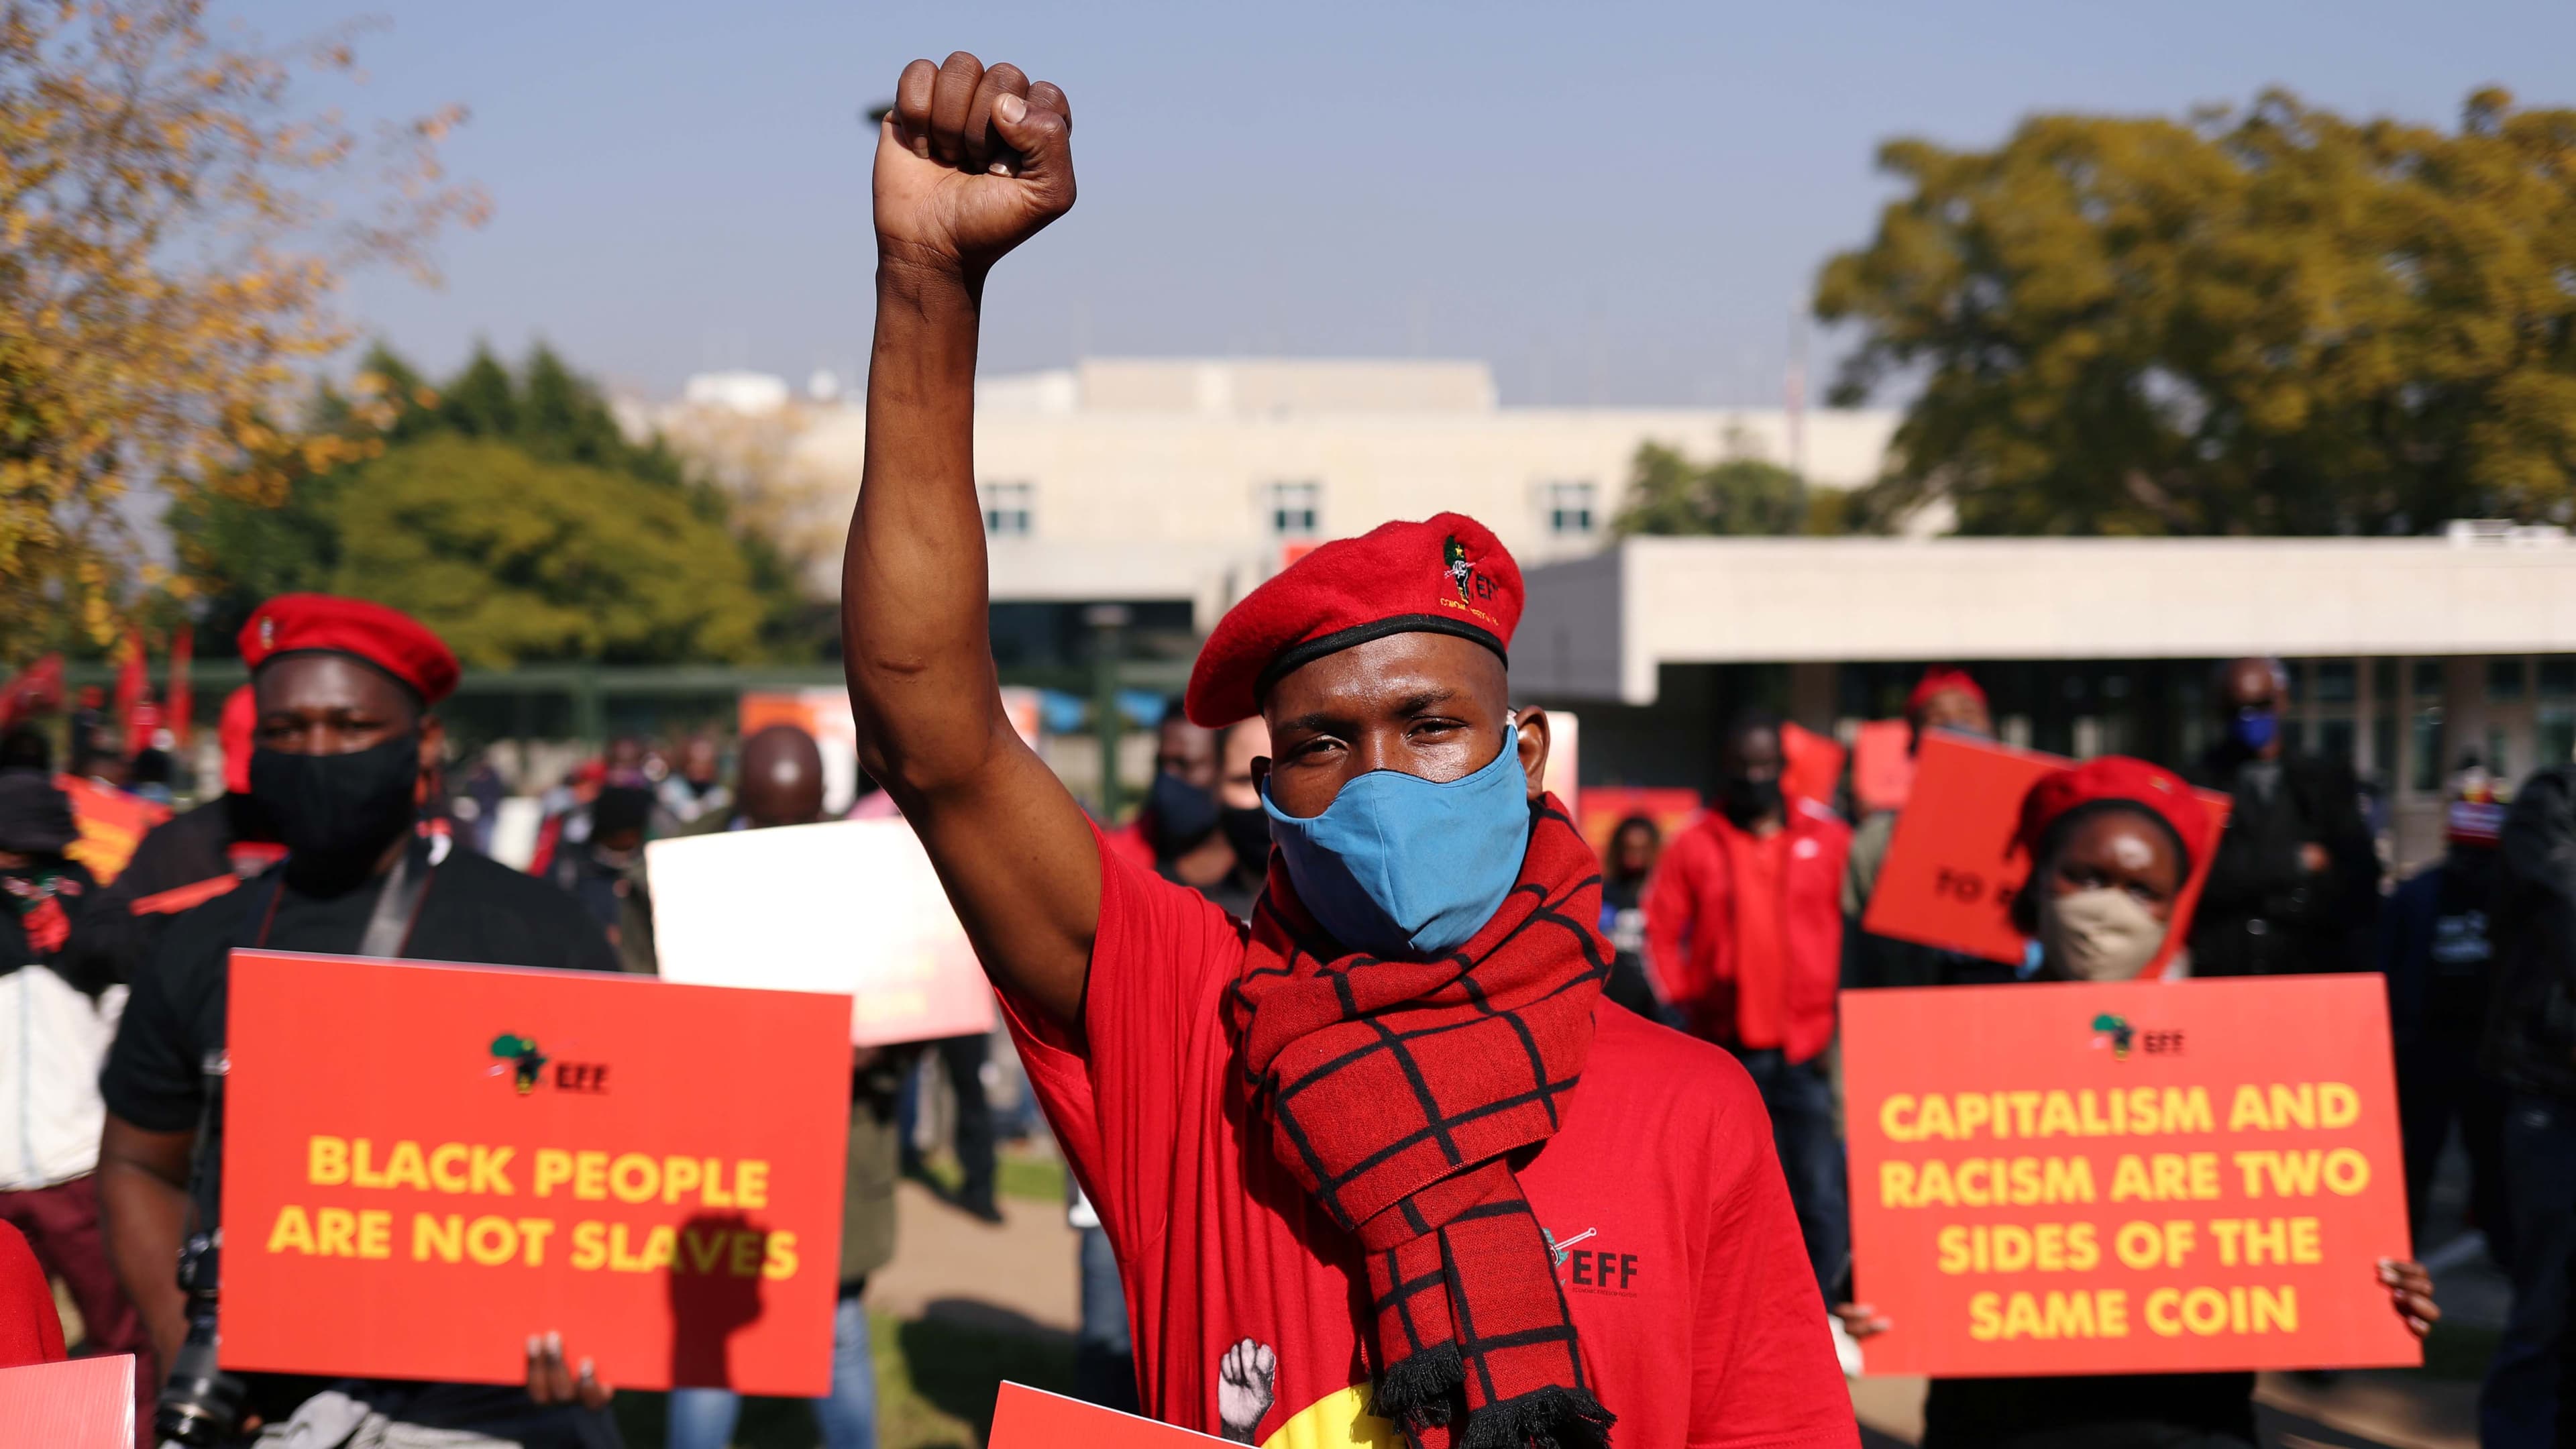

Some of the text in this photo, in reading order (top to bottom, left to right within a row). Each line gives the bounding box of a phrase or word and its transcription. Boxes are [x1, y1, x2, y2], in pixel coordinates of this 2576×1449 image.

[2145, 1031, 2184, 1054] EFF
[555, 1063, 609, 1091] EFF
[1880, 1082, 2361, 1142] CAPITALISM AND
[306, 1135, 769, 1208] BLACK PEOPLE
[1879, 1148, 2371, 1208] RACISM ARE TWO
[267, 1205, 799, 1280] ARE NOT SLAVES
[1572, 1249, 1638, 1289] EFF
[1937, 1217, 2322, 1275] SIDES OF THE
[1969, 1286, 2298, 1340] SAME COIN
